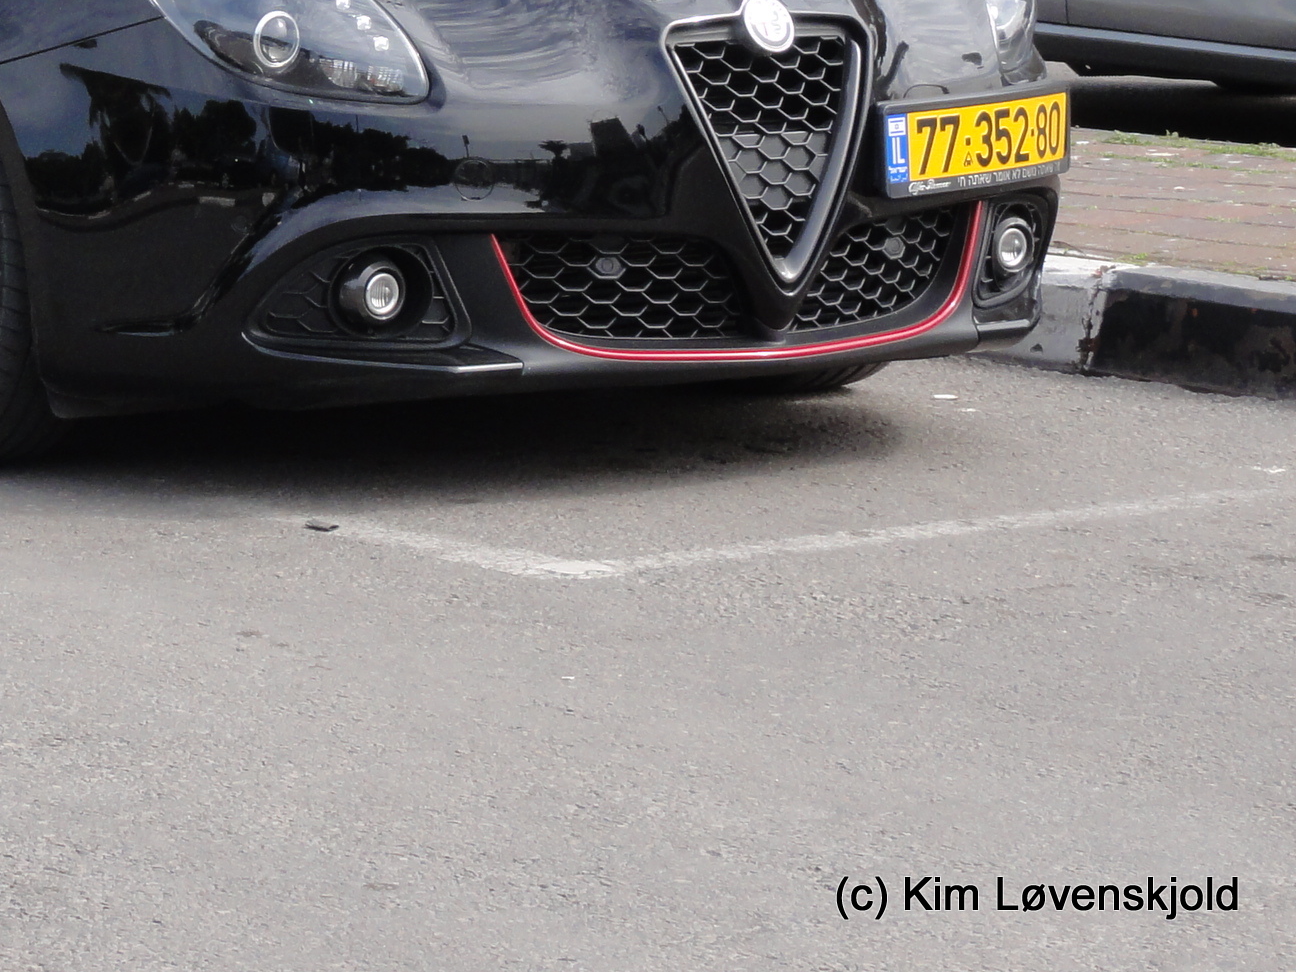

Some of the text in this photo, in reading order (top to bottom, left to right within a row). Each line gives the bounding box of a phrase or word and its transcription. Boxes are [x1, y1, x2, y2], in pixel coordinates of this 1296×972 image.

[891, 136, 906, 165] IL
[957, 177, 966, 188] חי
[968, 173, 992, 186] שאתה
